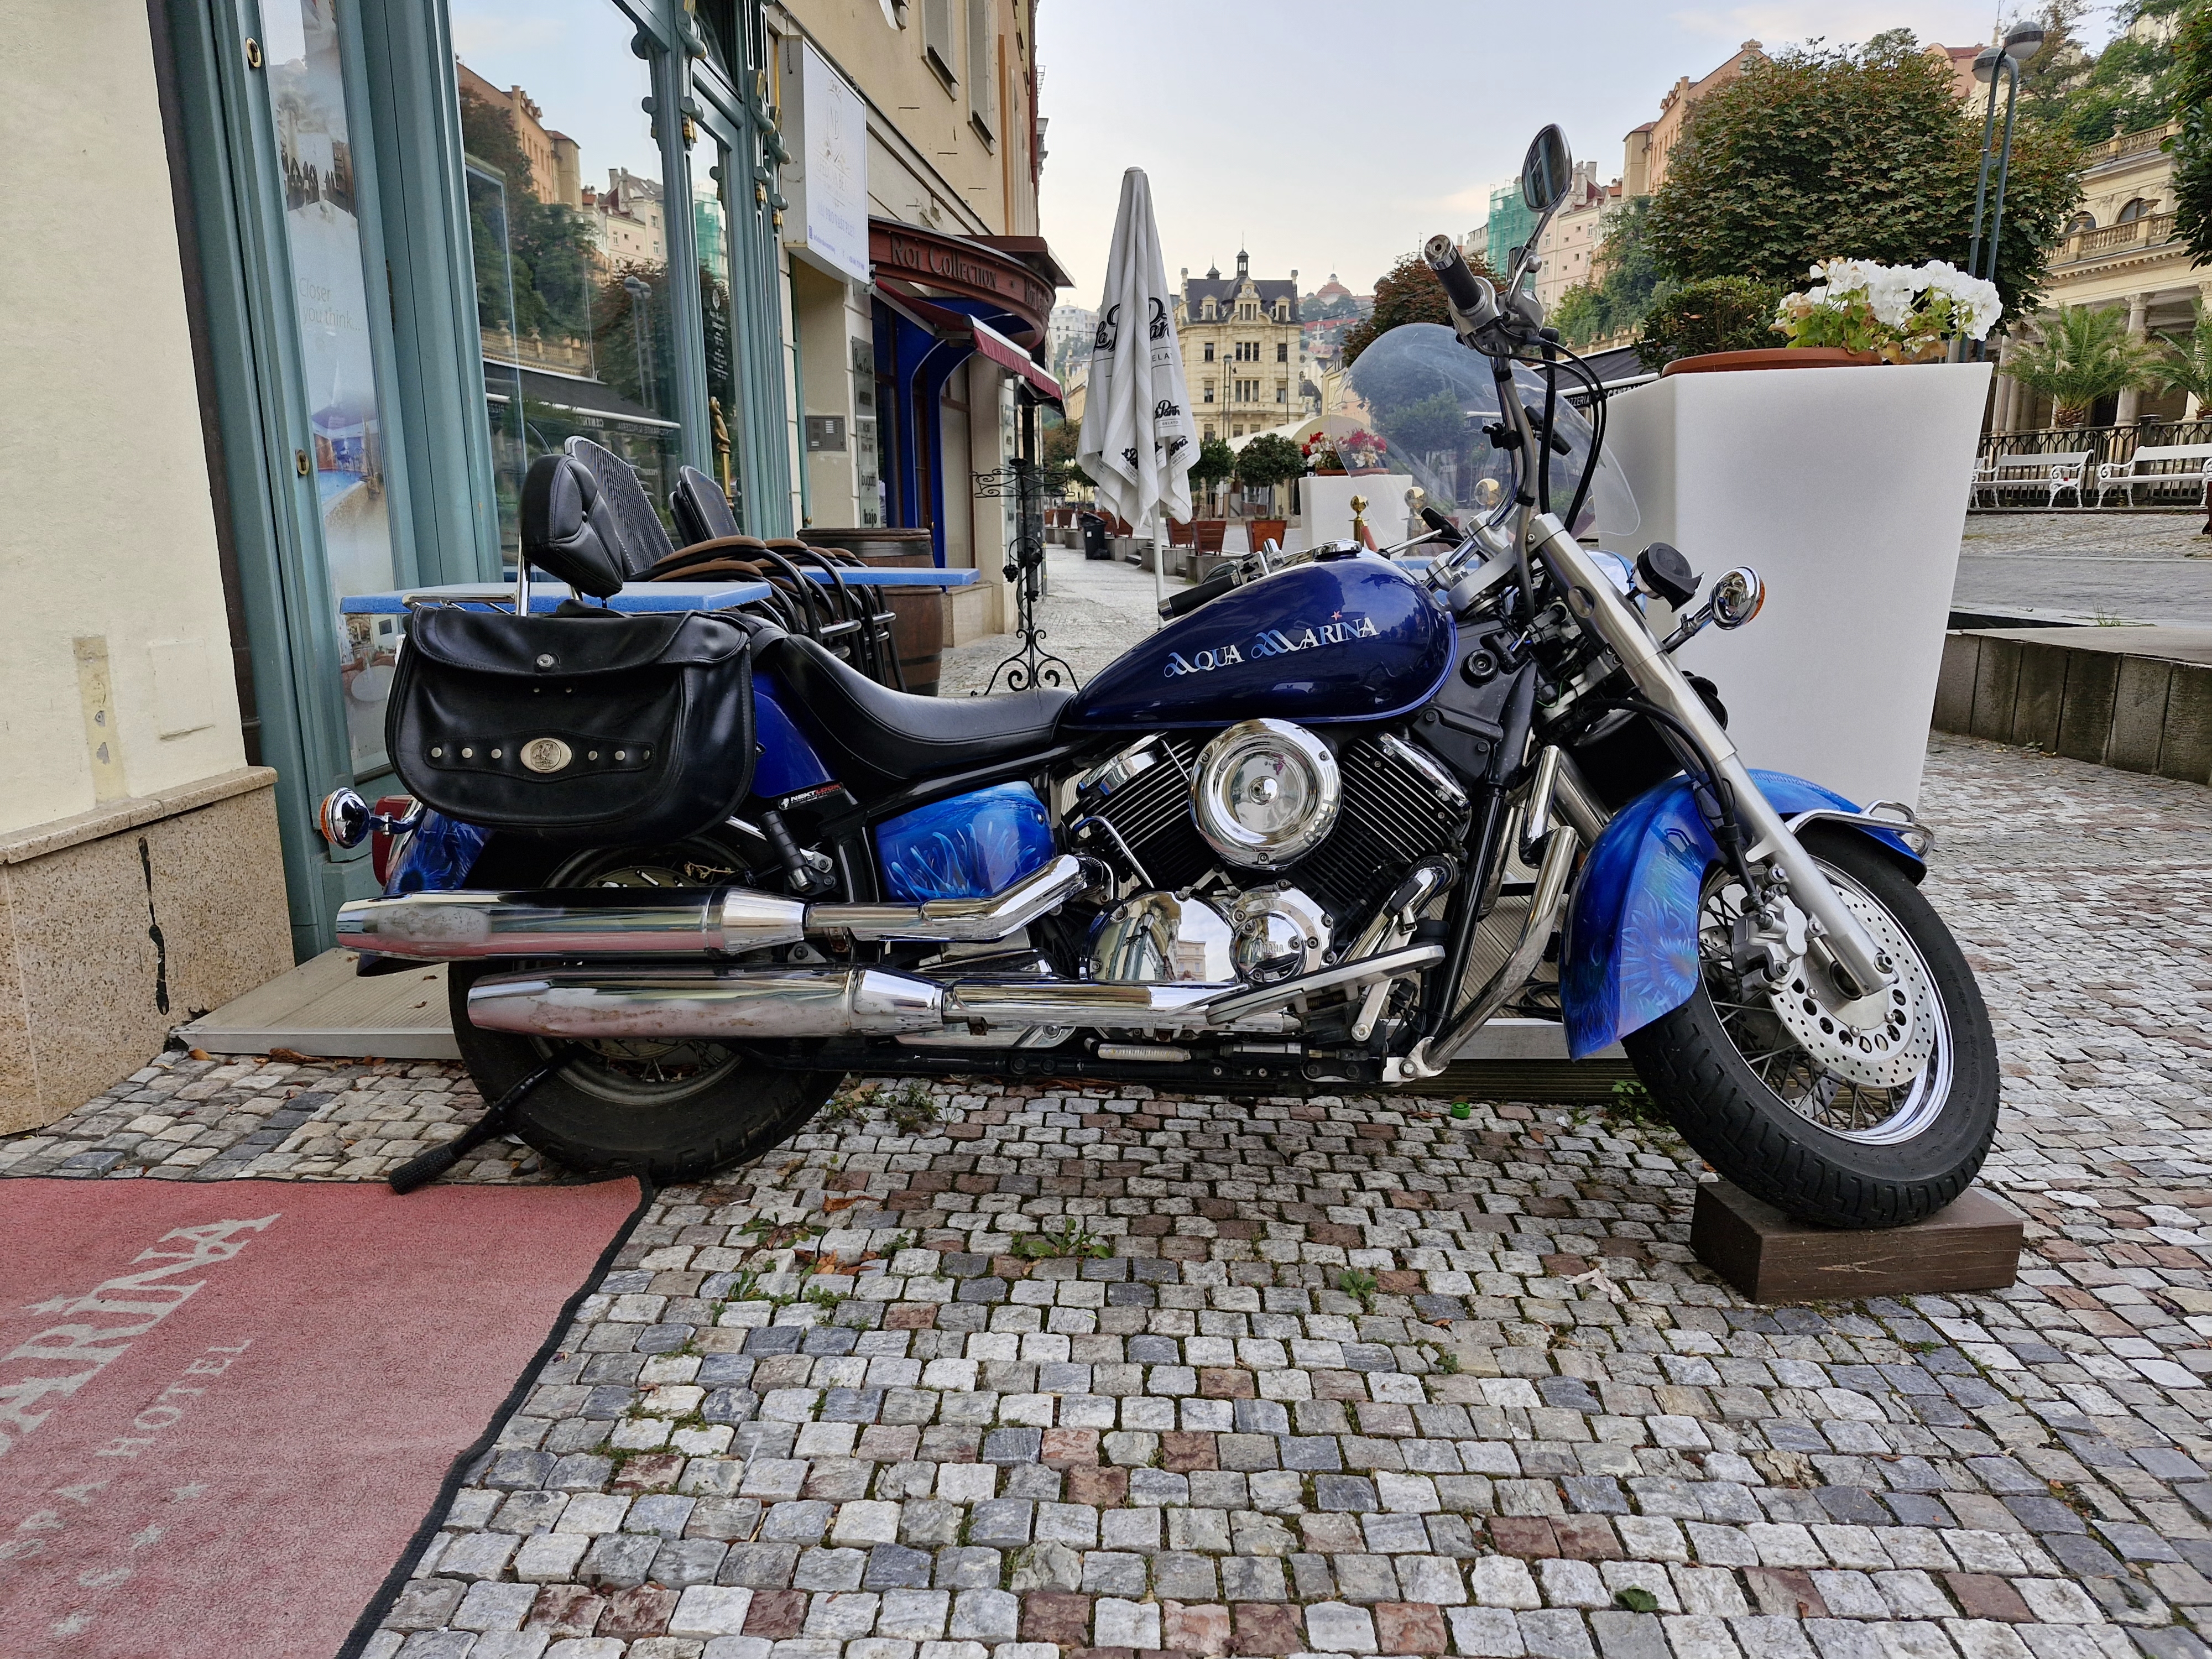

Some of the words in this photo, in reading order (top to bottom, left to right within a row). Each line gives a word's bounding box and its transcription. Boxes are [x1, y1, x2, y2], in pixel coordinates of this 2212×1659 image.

[299, 278, 330, 302] Closer
[304, 307, 321, 325] you
[1151, 353, 1172, 362] ELA
[864, 508, 878, 528] hajo
[1164, 644, 1245, 678] AQUA
[1251, 617, 1380, 659] MARINA
[1251, 943, 1284, 953] YAMAHA
[0, 1213, 282, 1454] ARINA
[95, 1339, 254, 1458] HOTEL
